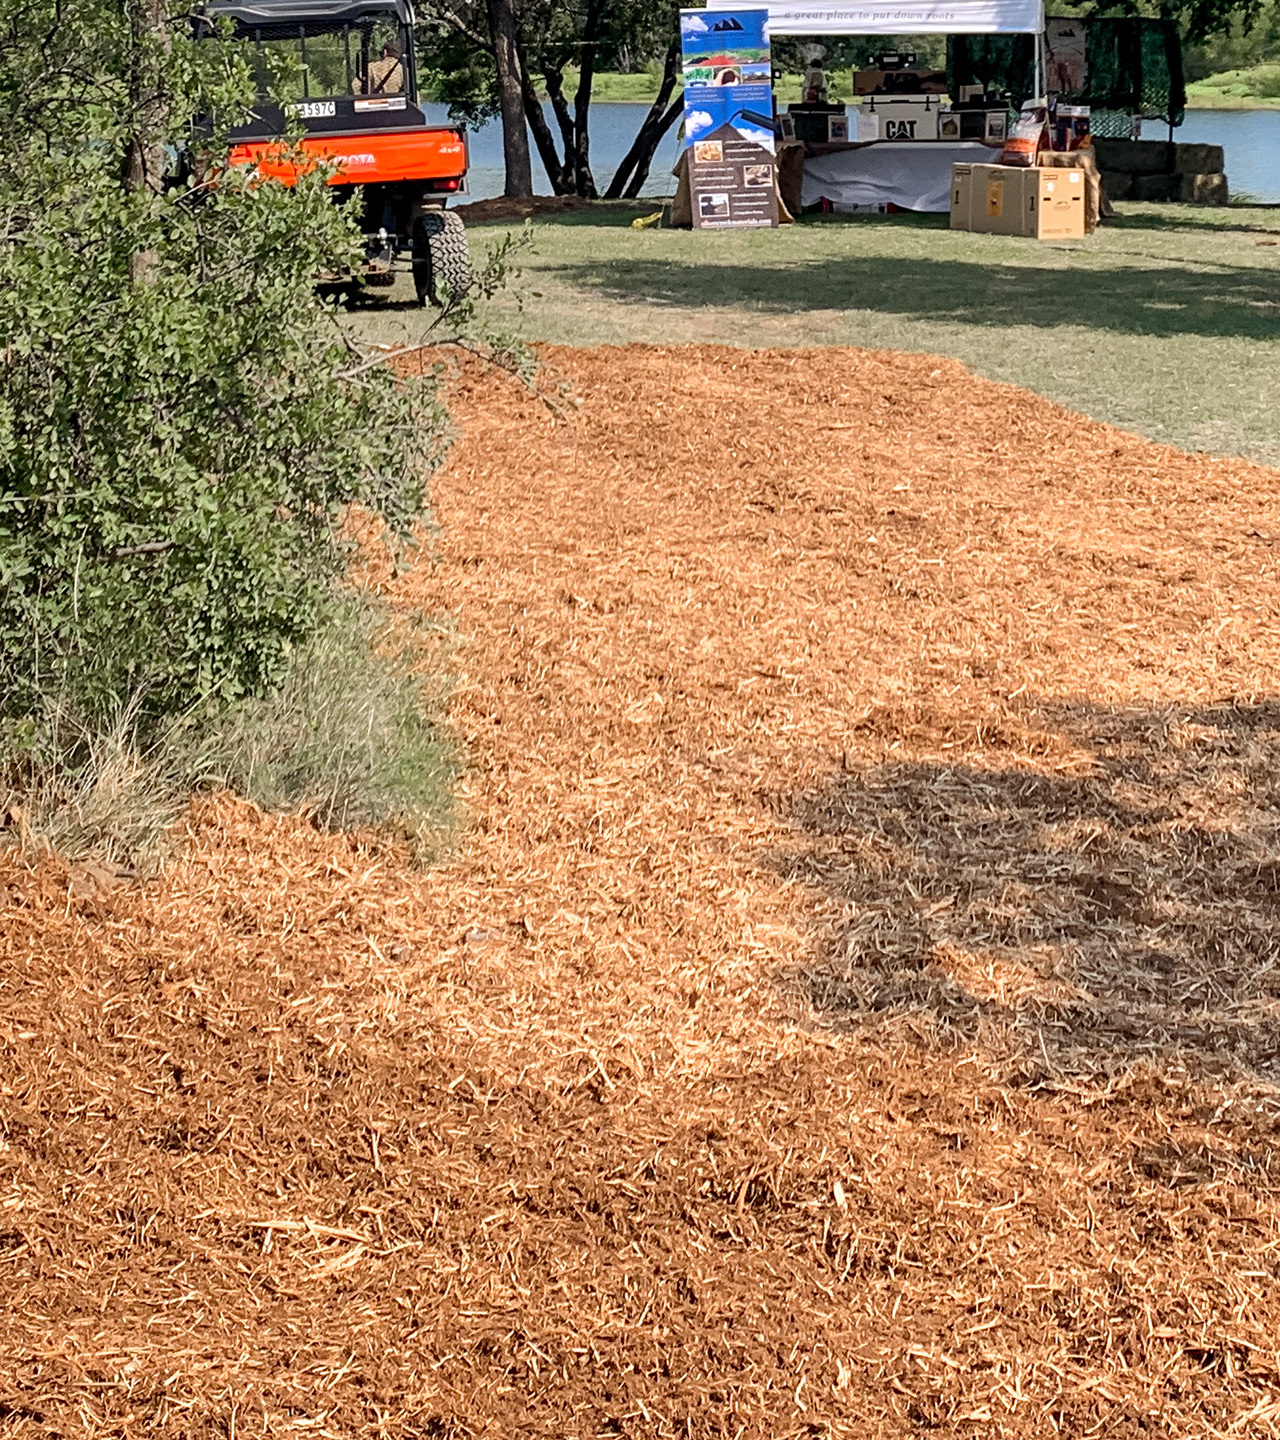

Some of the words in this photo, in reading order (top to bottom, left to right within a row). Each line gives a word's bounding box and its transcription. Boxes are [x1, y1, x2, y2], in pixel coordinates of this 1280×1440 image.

[794, 11, 823, 20] great
[827, 11, 855, 20] place
[859, 11, 869, 19] to
[872, 11, 891, 20] put
[894, 10, 923, 19] down
[926, 11, 955, 20] roots
[885, 120, 917, 139] CAT
